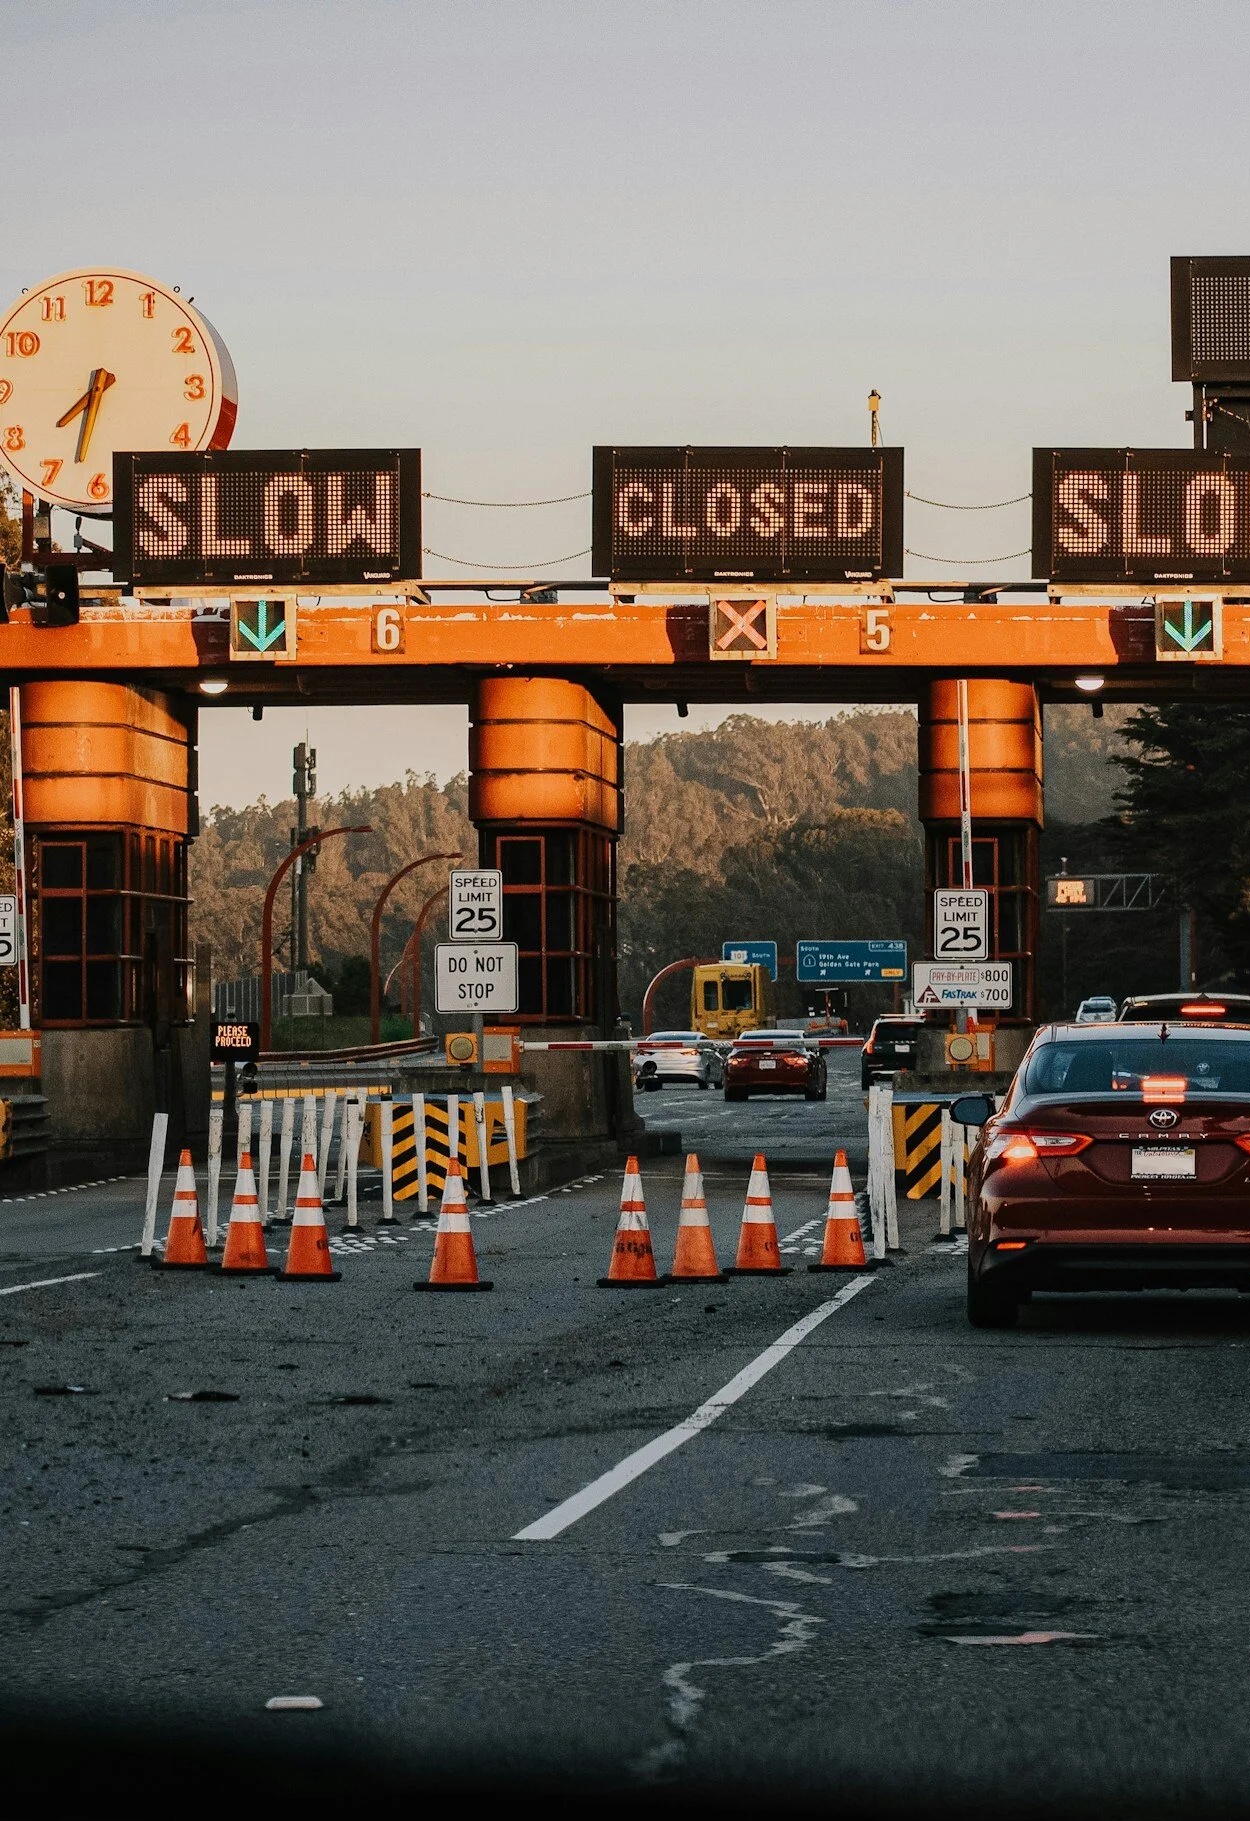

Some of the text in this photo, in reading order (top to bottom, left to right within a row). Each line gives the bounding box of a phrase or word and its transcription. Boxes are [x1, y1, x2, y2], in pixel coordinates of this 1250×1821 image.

[82, 280, 114, 307] 12
[139, 292, 155, 318] 1
[39, 296, 66, 321] 11
[4, 331, 40, 357] 10
[172, 326, 195, 353] 2
[183, 374, 207, 401] 3
[4, 425, 26, 451] 8
[169, 422, 192, 448] 4
[40, 459, 63, 486] 7
[87, 473, 110, 499] 6
[139, 475, 390, 556] SLOW
[618, 482, 873, 538] CLOSED
[377, 608, 400, 650] 6
[866, 610, 890, 650] 5
[455, 878, 497, 888] SPEED
[459, 893, 492, 902] LIMIT
[940, 898, 982, 907] SPEED
[456, 908, 497, 932] 25
[944, 912, 978, 922] LIMIT
[940, 927, 981, 951] 25
[449, 957, 503, 973] DO NOT
[932, 972, 976, 981] PAY-BY-PLATE
[458, 984, 494, 999] STOP
[218, 1025, 248, 1037] PLEASE
